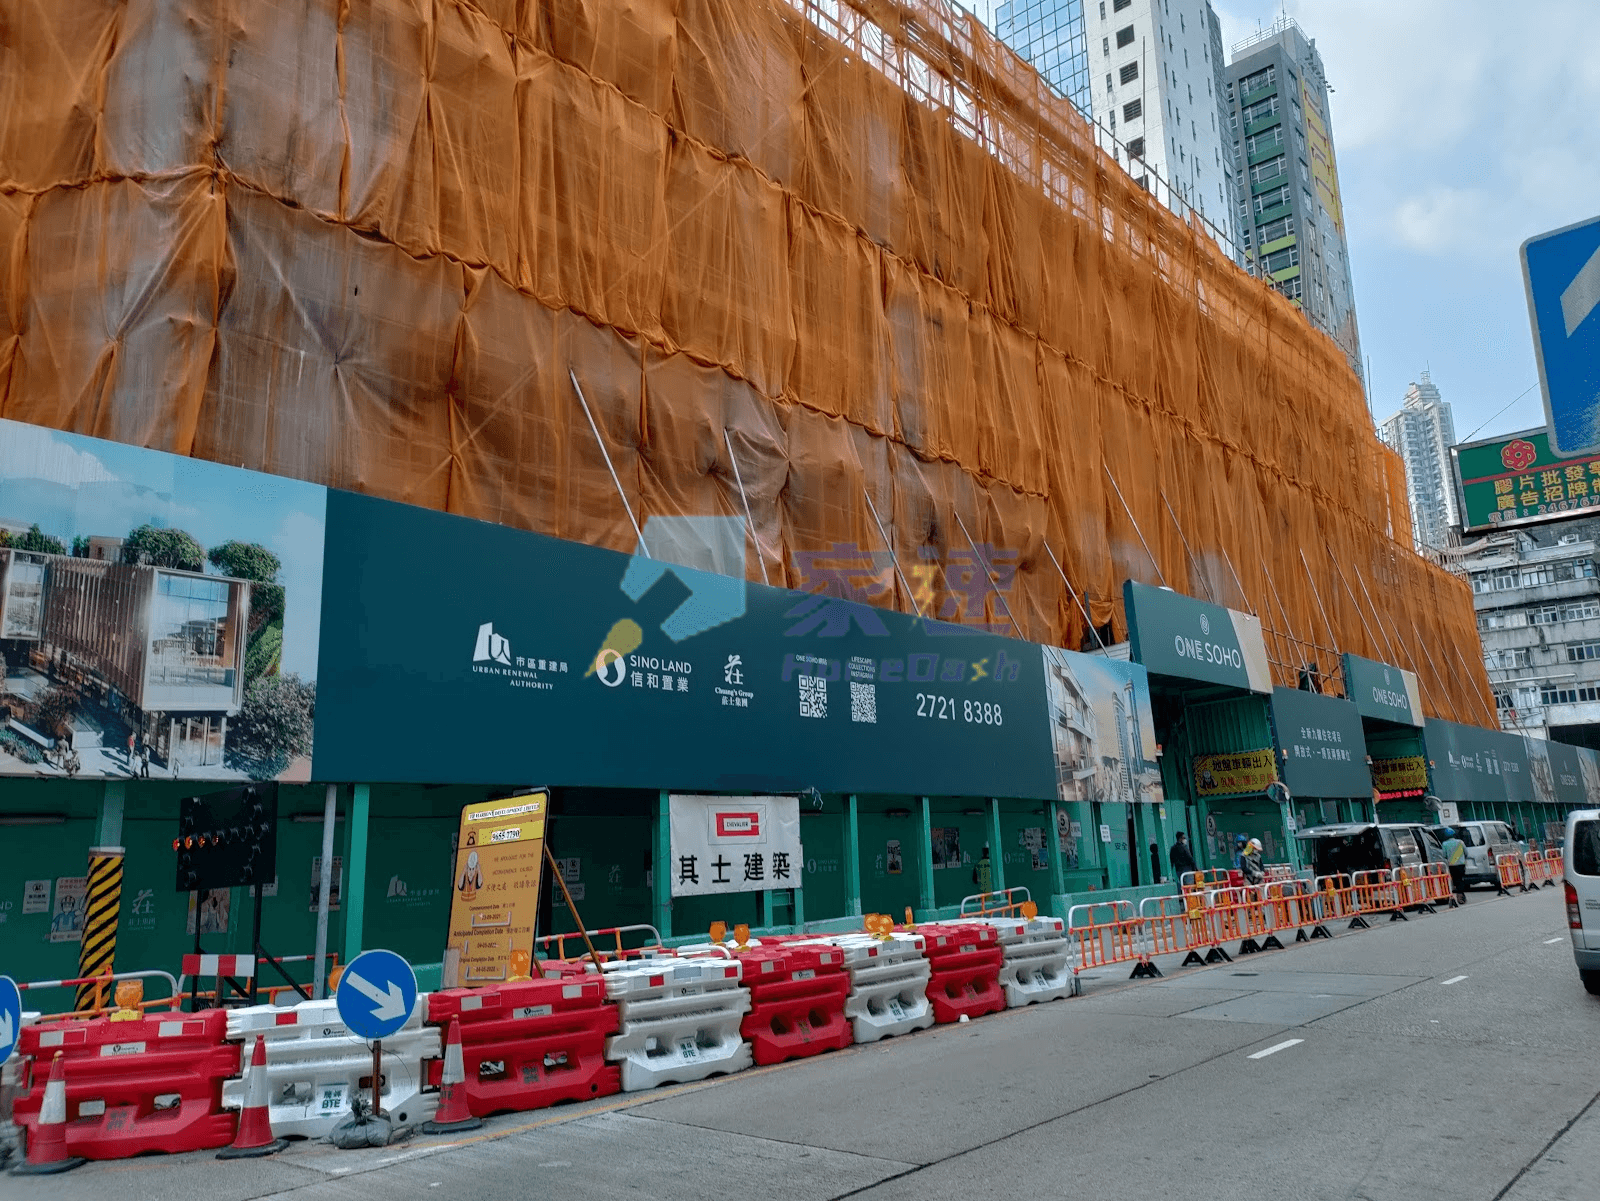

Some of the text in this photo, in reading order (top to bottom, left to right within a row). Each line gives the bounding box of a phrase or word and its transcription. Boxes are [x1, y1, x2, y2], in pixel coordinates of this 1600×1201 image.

[1174, 635, 1242, 669] ONE SOHO
[515, 655, 569, 674] 市區重建局
[630, 655, 692, 674] SINO LAND
[848, 663, 876, 673] COLLECTIONS
[851, 656, 872, 666] LIFESCAPE
[472, 665, 538, 679] URBAN RENEWAL
[851, 670, 874, 680] INSTAGRAM
[510, 679, 554, 691] AUTHORITY
[630, 671, 689, 693] 信和置業
[714, 686, 754, 699] Chuang's Group
[1372, 686, 1408, 710] ONE SOHO
[916, 693, 1003, 726] 2721 8388
[1114, 842, 1128, 851] 安全
[678, 852, 790, 886] 其士建築
[322, 1099, 341, 1109] BTE
